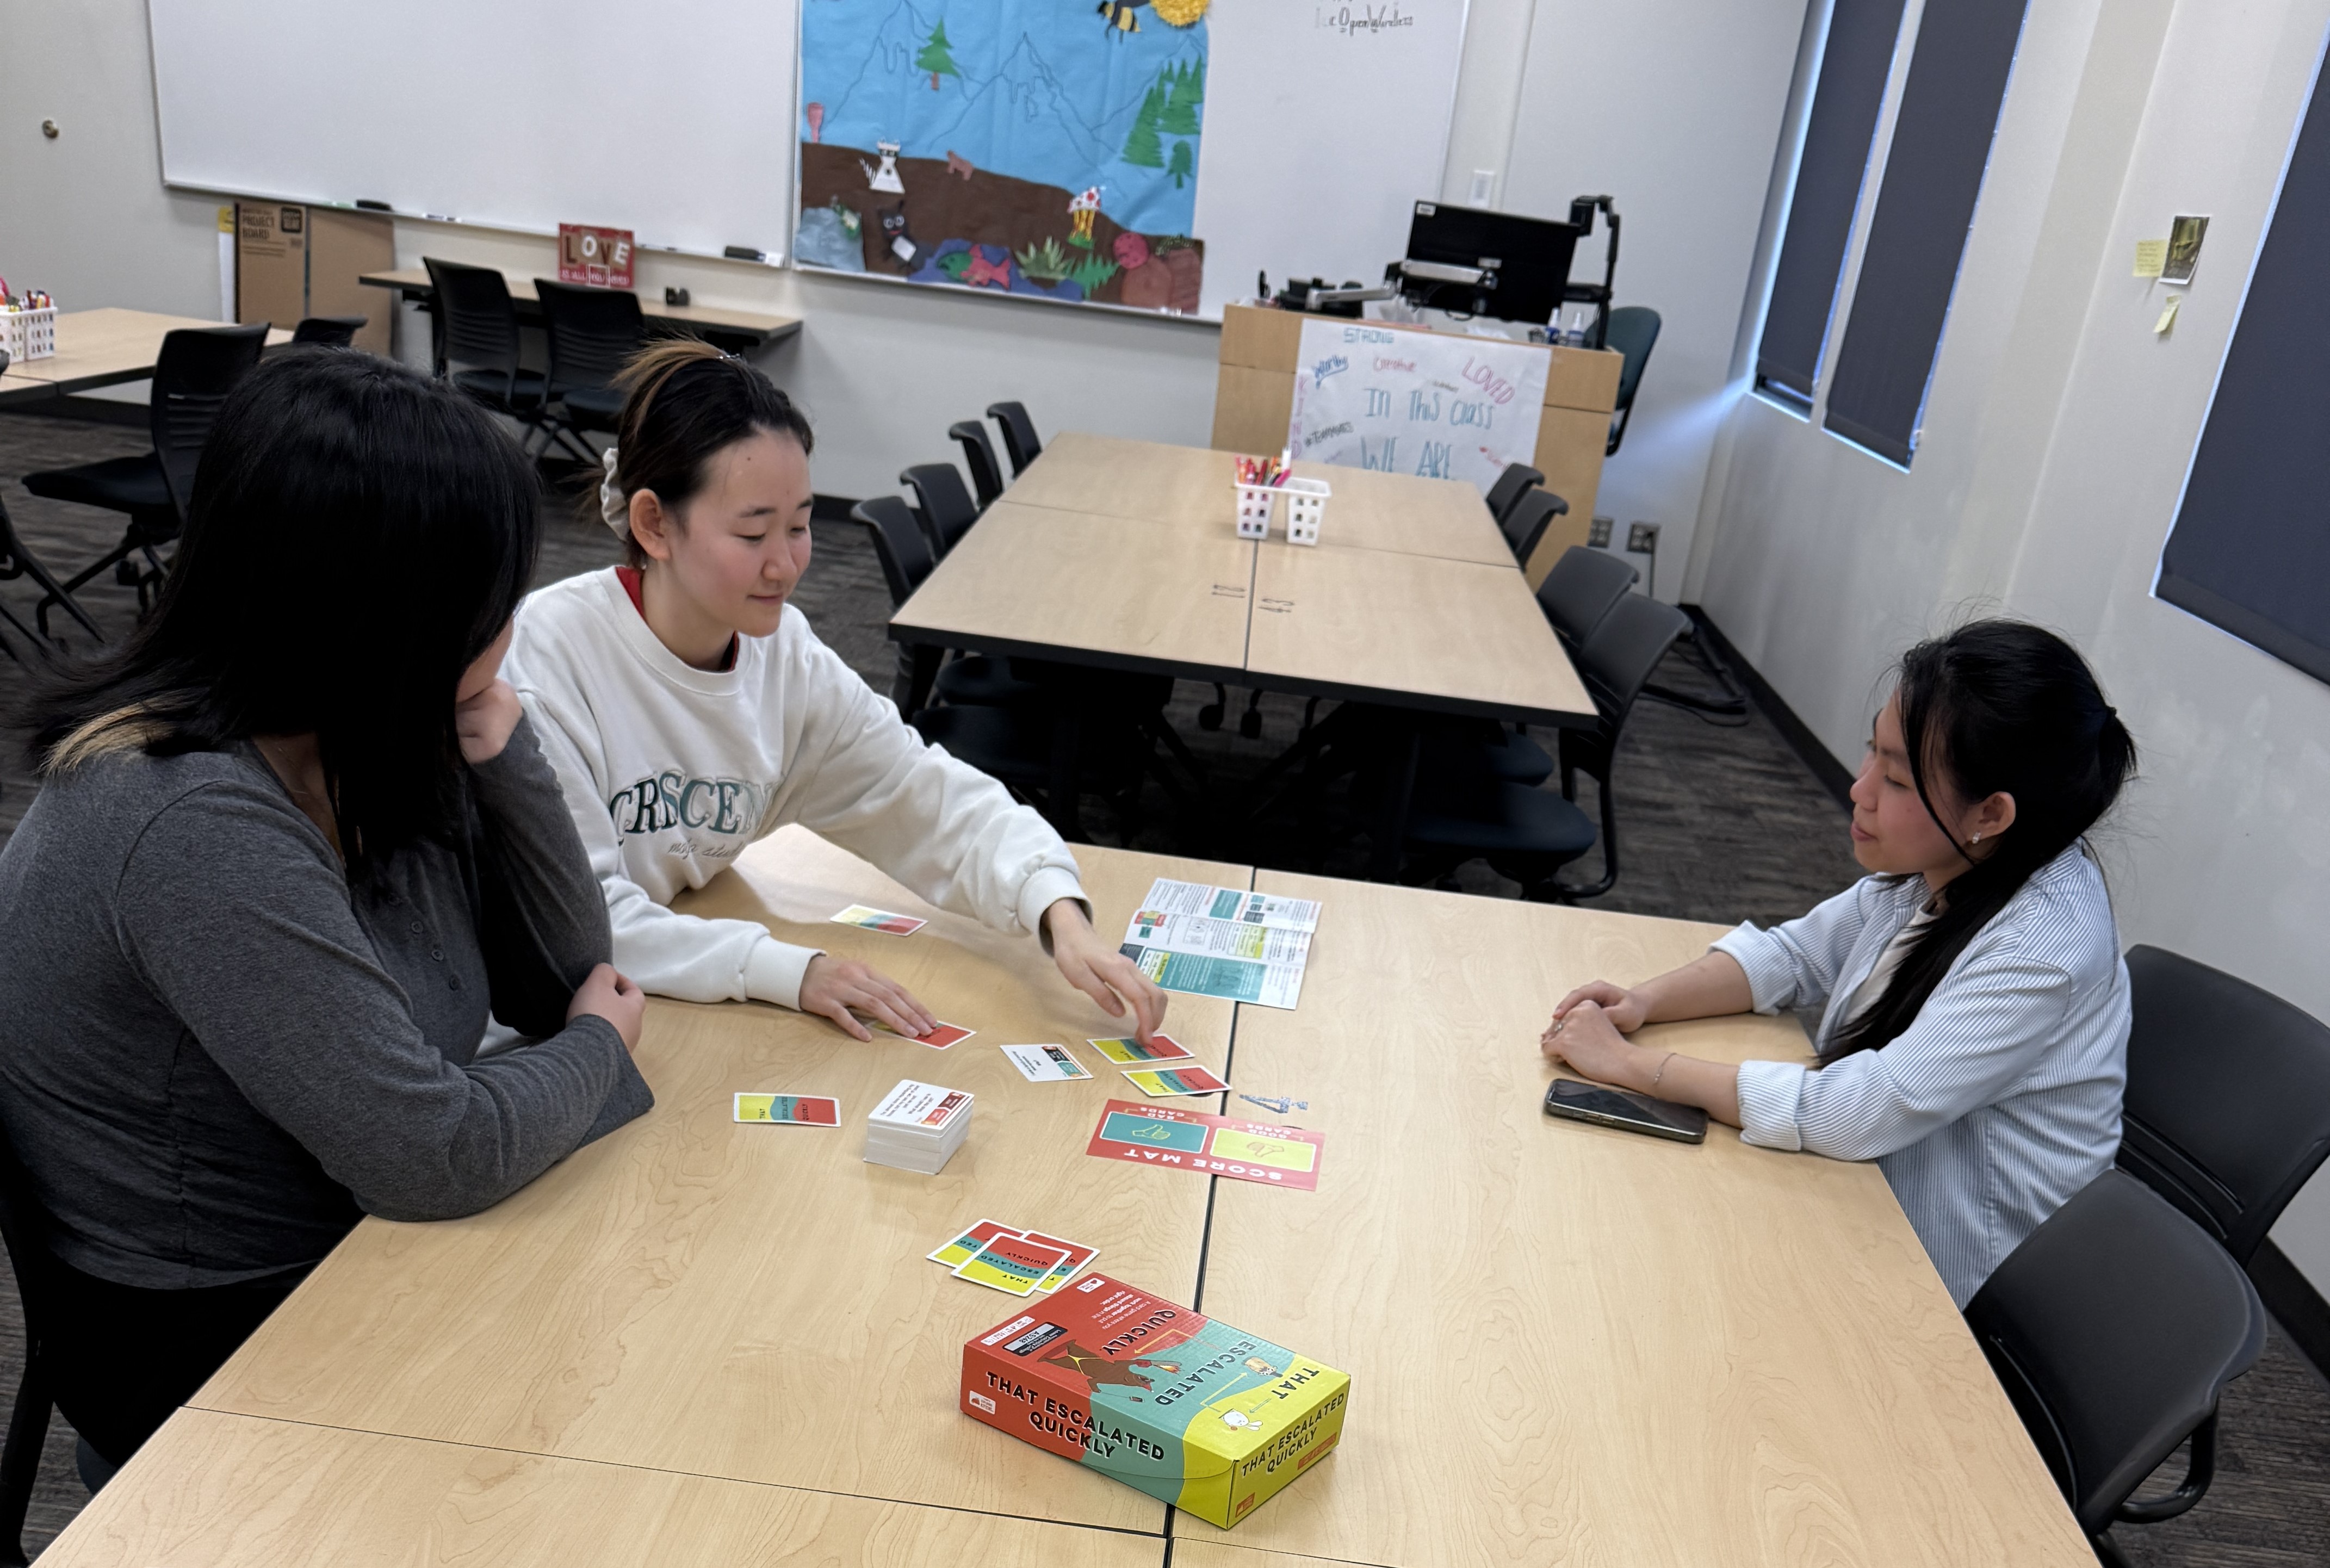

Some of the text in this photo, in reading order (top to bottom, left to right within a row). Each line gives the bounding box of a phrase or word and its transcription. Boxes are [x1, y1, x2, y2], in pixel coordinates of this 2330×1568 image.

[565, 234, 630, 265] LOVE
[1461, 356, 1516, 405] LOVED
[1141, 1107, 1185, 1117] CARDS
[1247, 1124, 1292, 1135] CARDS
[1248, 1129, 1287, 1139] GOOD
[1124, 1149, 1282, 1181] SCORE MAT
[981, 1255, 1039, 1275] ESCALATED
[1006, 1251, 1048, 1266] QUICKLY
[1002, 1274, 1028, 1284] THAT
[1108, 1303, 1133, 1316] together
[1127, 1296, 1143, 1305] work
[1155, 1339, 1257, 1405] ESCALATED
[1271, 1367, 1320, 1399] THAT
[986, 1371, 1165, 1462] THAT ESCALATED
[1028, 1411, 1116, 1459] QUICKLY
[1242, 1443, 1275, 1478] THAT
[1278, 1392, 1345, 1451] ESCALATED
[1266, 1426, 1317, 1475] QUICKLY
